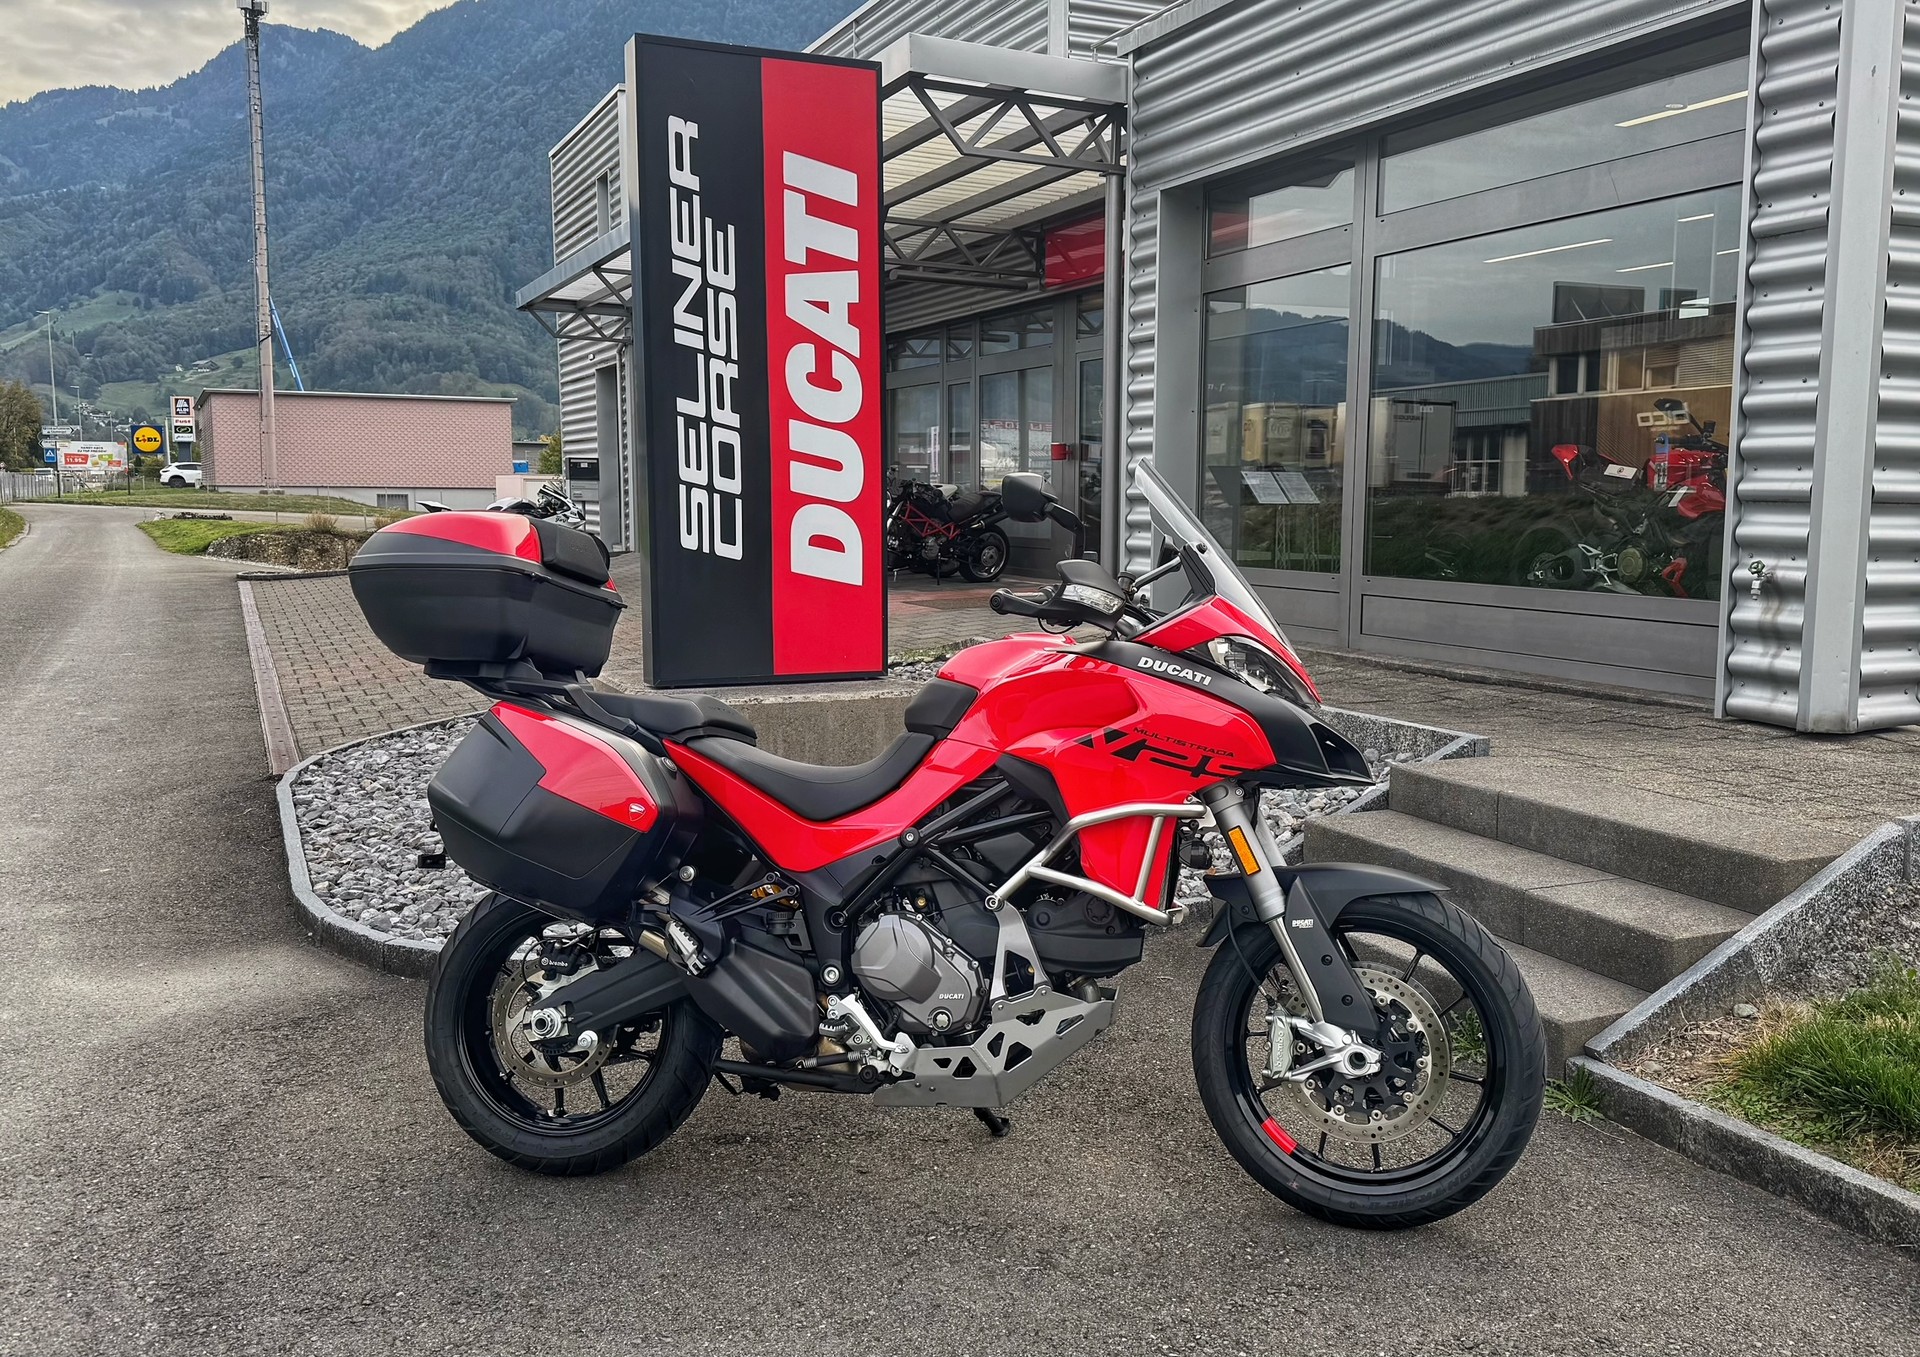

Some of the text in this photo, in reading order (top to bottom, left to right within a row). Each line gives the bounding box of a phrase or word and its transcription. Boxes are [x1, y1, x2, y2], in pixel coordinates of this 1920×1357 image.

[667, 114, 711, 555] SELINER
[704, 216, 743, 562] CORSE
[782, 149, 865, 586] DUCATI
[1133, 726, 1235, 758] MULTISTRADA
[1137, 656, 1212, 686] DUCATI
